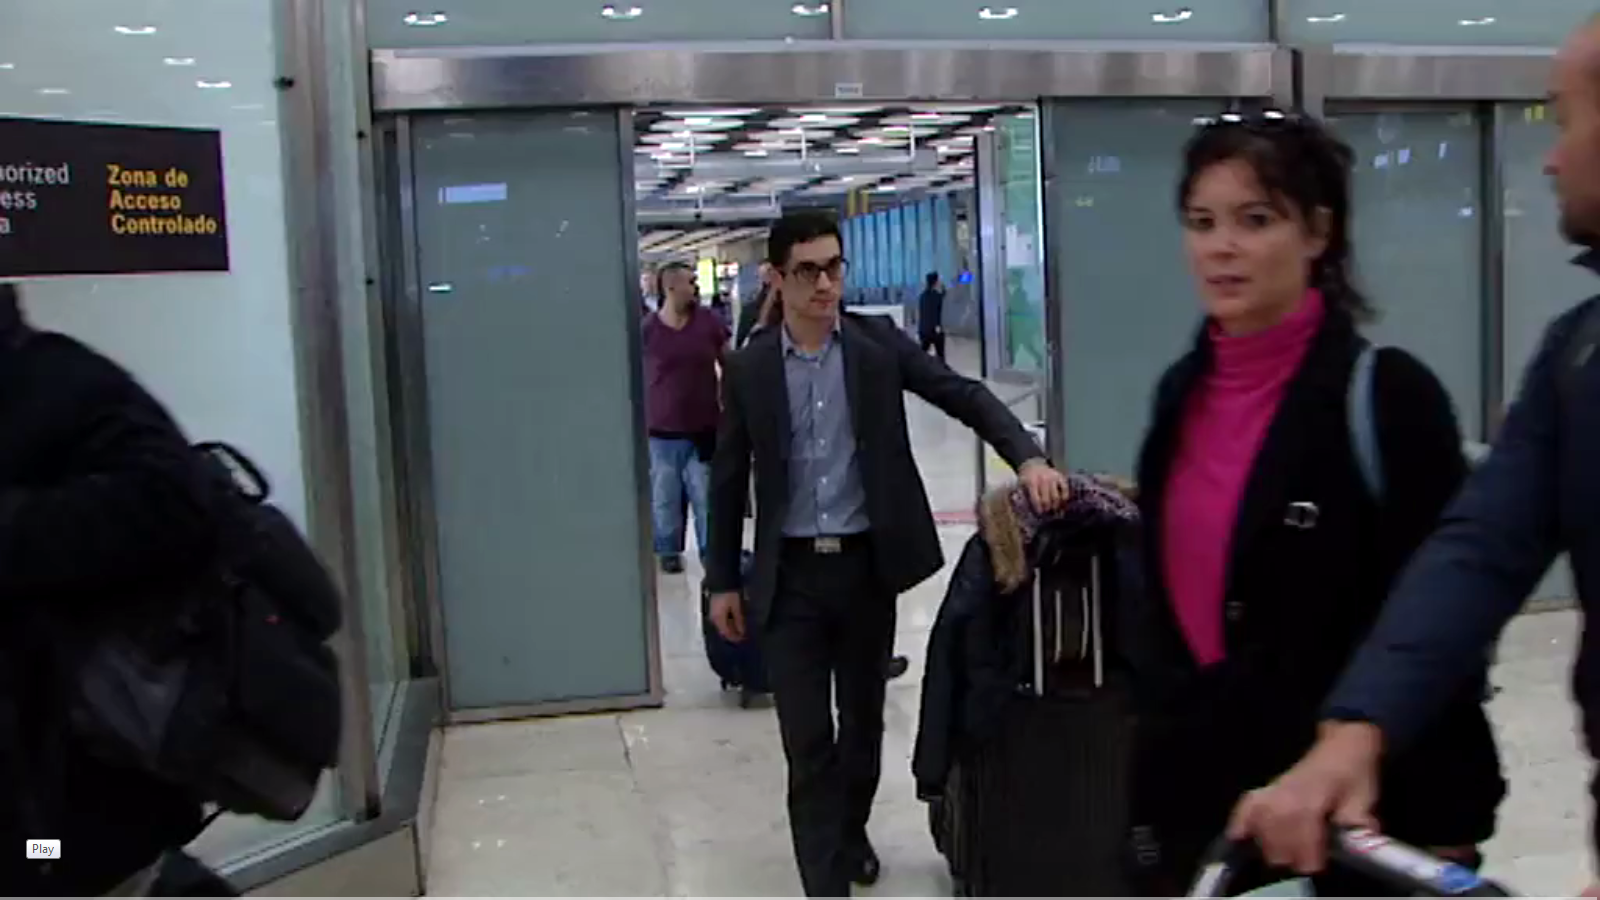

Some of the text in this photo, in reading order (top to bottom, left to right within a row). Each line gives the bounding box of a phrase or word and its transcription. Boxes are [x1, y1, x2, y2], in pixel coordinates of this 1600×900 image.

[106, 163, 189, 188] Zona de
[109, 189, 181, 211] Acceso
[111, 213, 218, 235] Controlado
